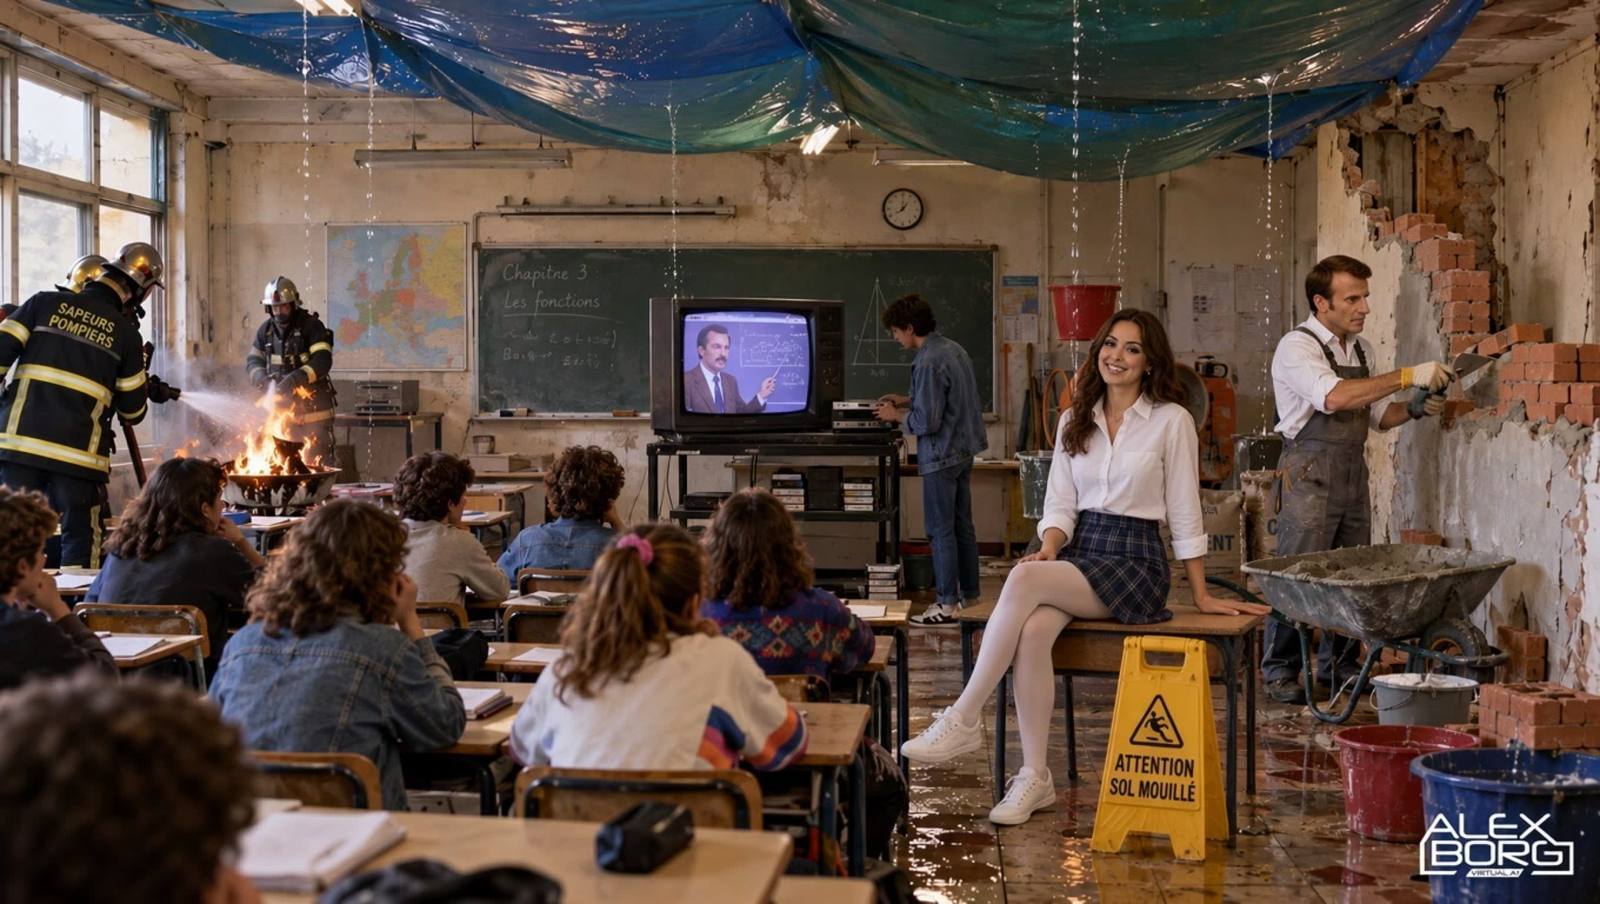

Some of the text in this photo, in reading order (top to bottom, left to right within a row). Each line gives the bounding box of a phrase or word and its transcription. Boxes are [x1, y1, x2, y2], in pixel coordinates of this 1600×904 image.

[577, 263, 588, 280] 3
[504, 290, 600, 317] Les fonctions
[58, 302, 115, 333] SAPEURS
[48, 314, 114, 349] POMPIERS
[1115, 753, 1195, 778] ATTENTION
[1109, 778, 1196, 802] SOL MOUILLÉ
